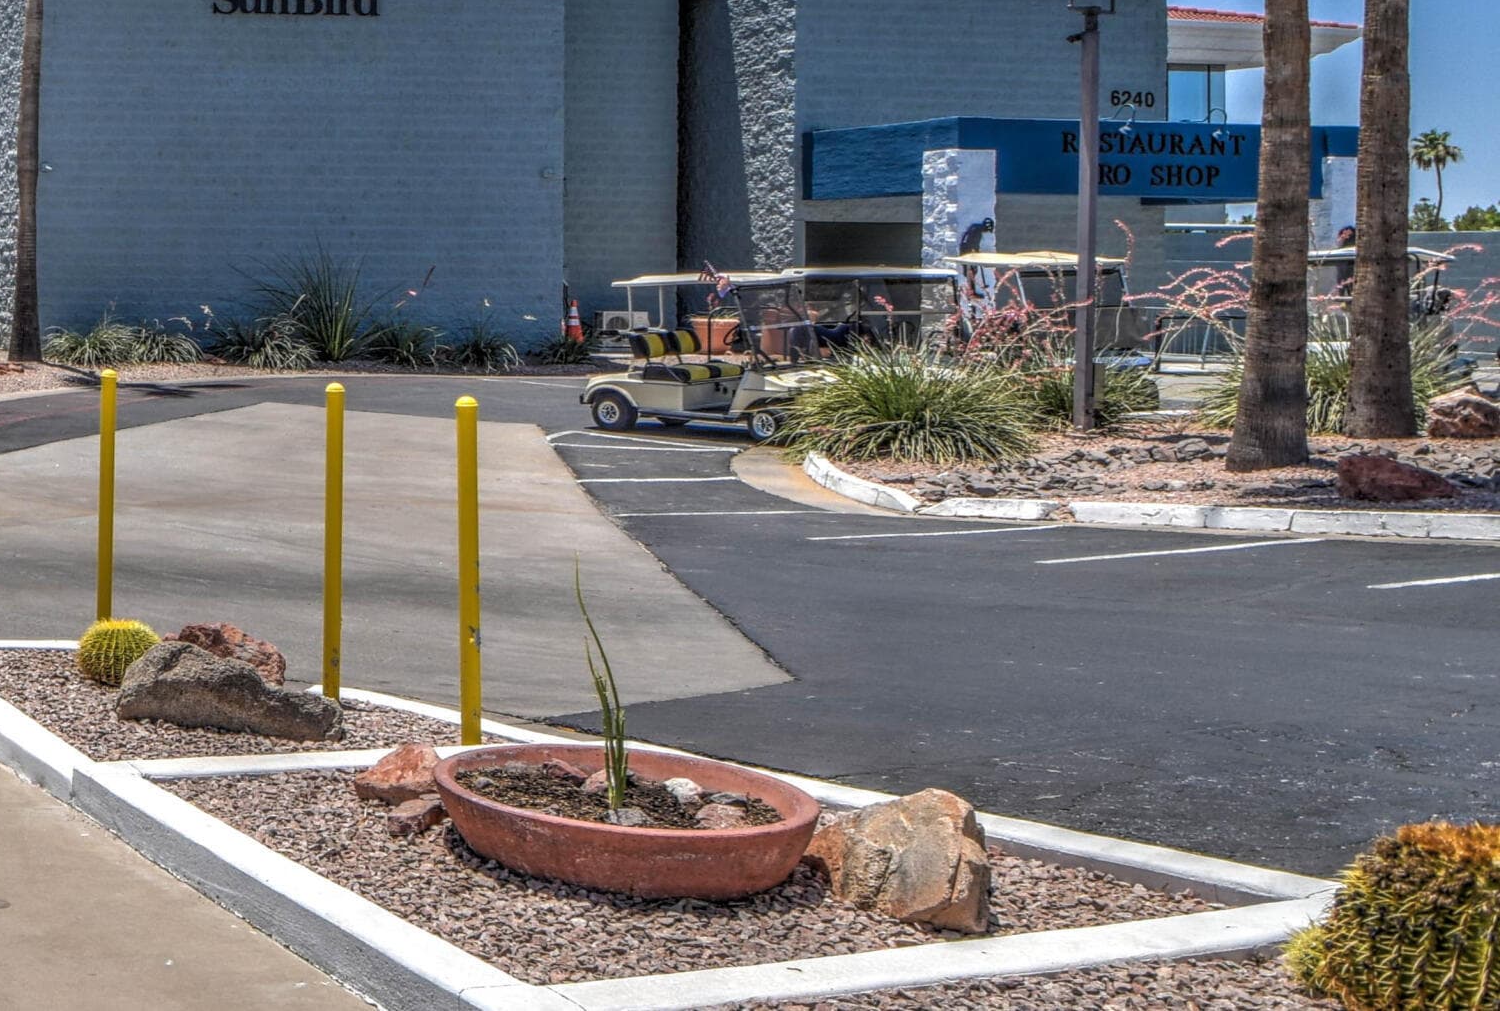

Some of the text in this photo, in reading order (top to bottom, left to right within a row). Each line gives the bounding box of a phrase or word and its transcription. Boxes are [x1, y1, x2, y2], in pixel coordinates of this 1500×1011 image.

[1110, 90, 1155, 108] 6240
[1062, 131, 1245, 156] RSTAURANT
[1097, 163, 1220, 187] RO SHOP
